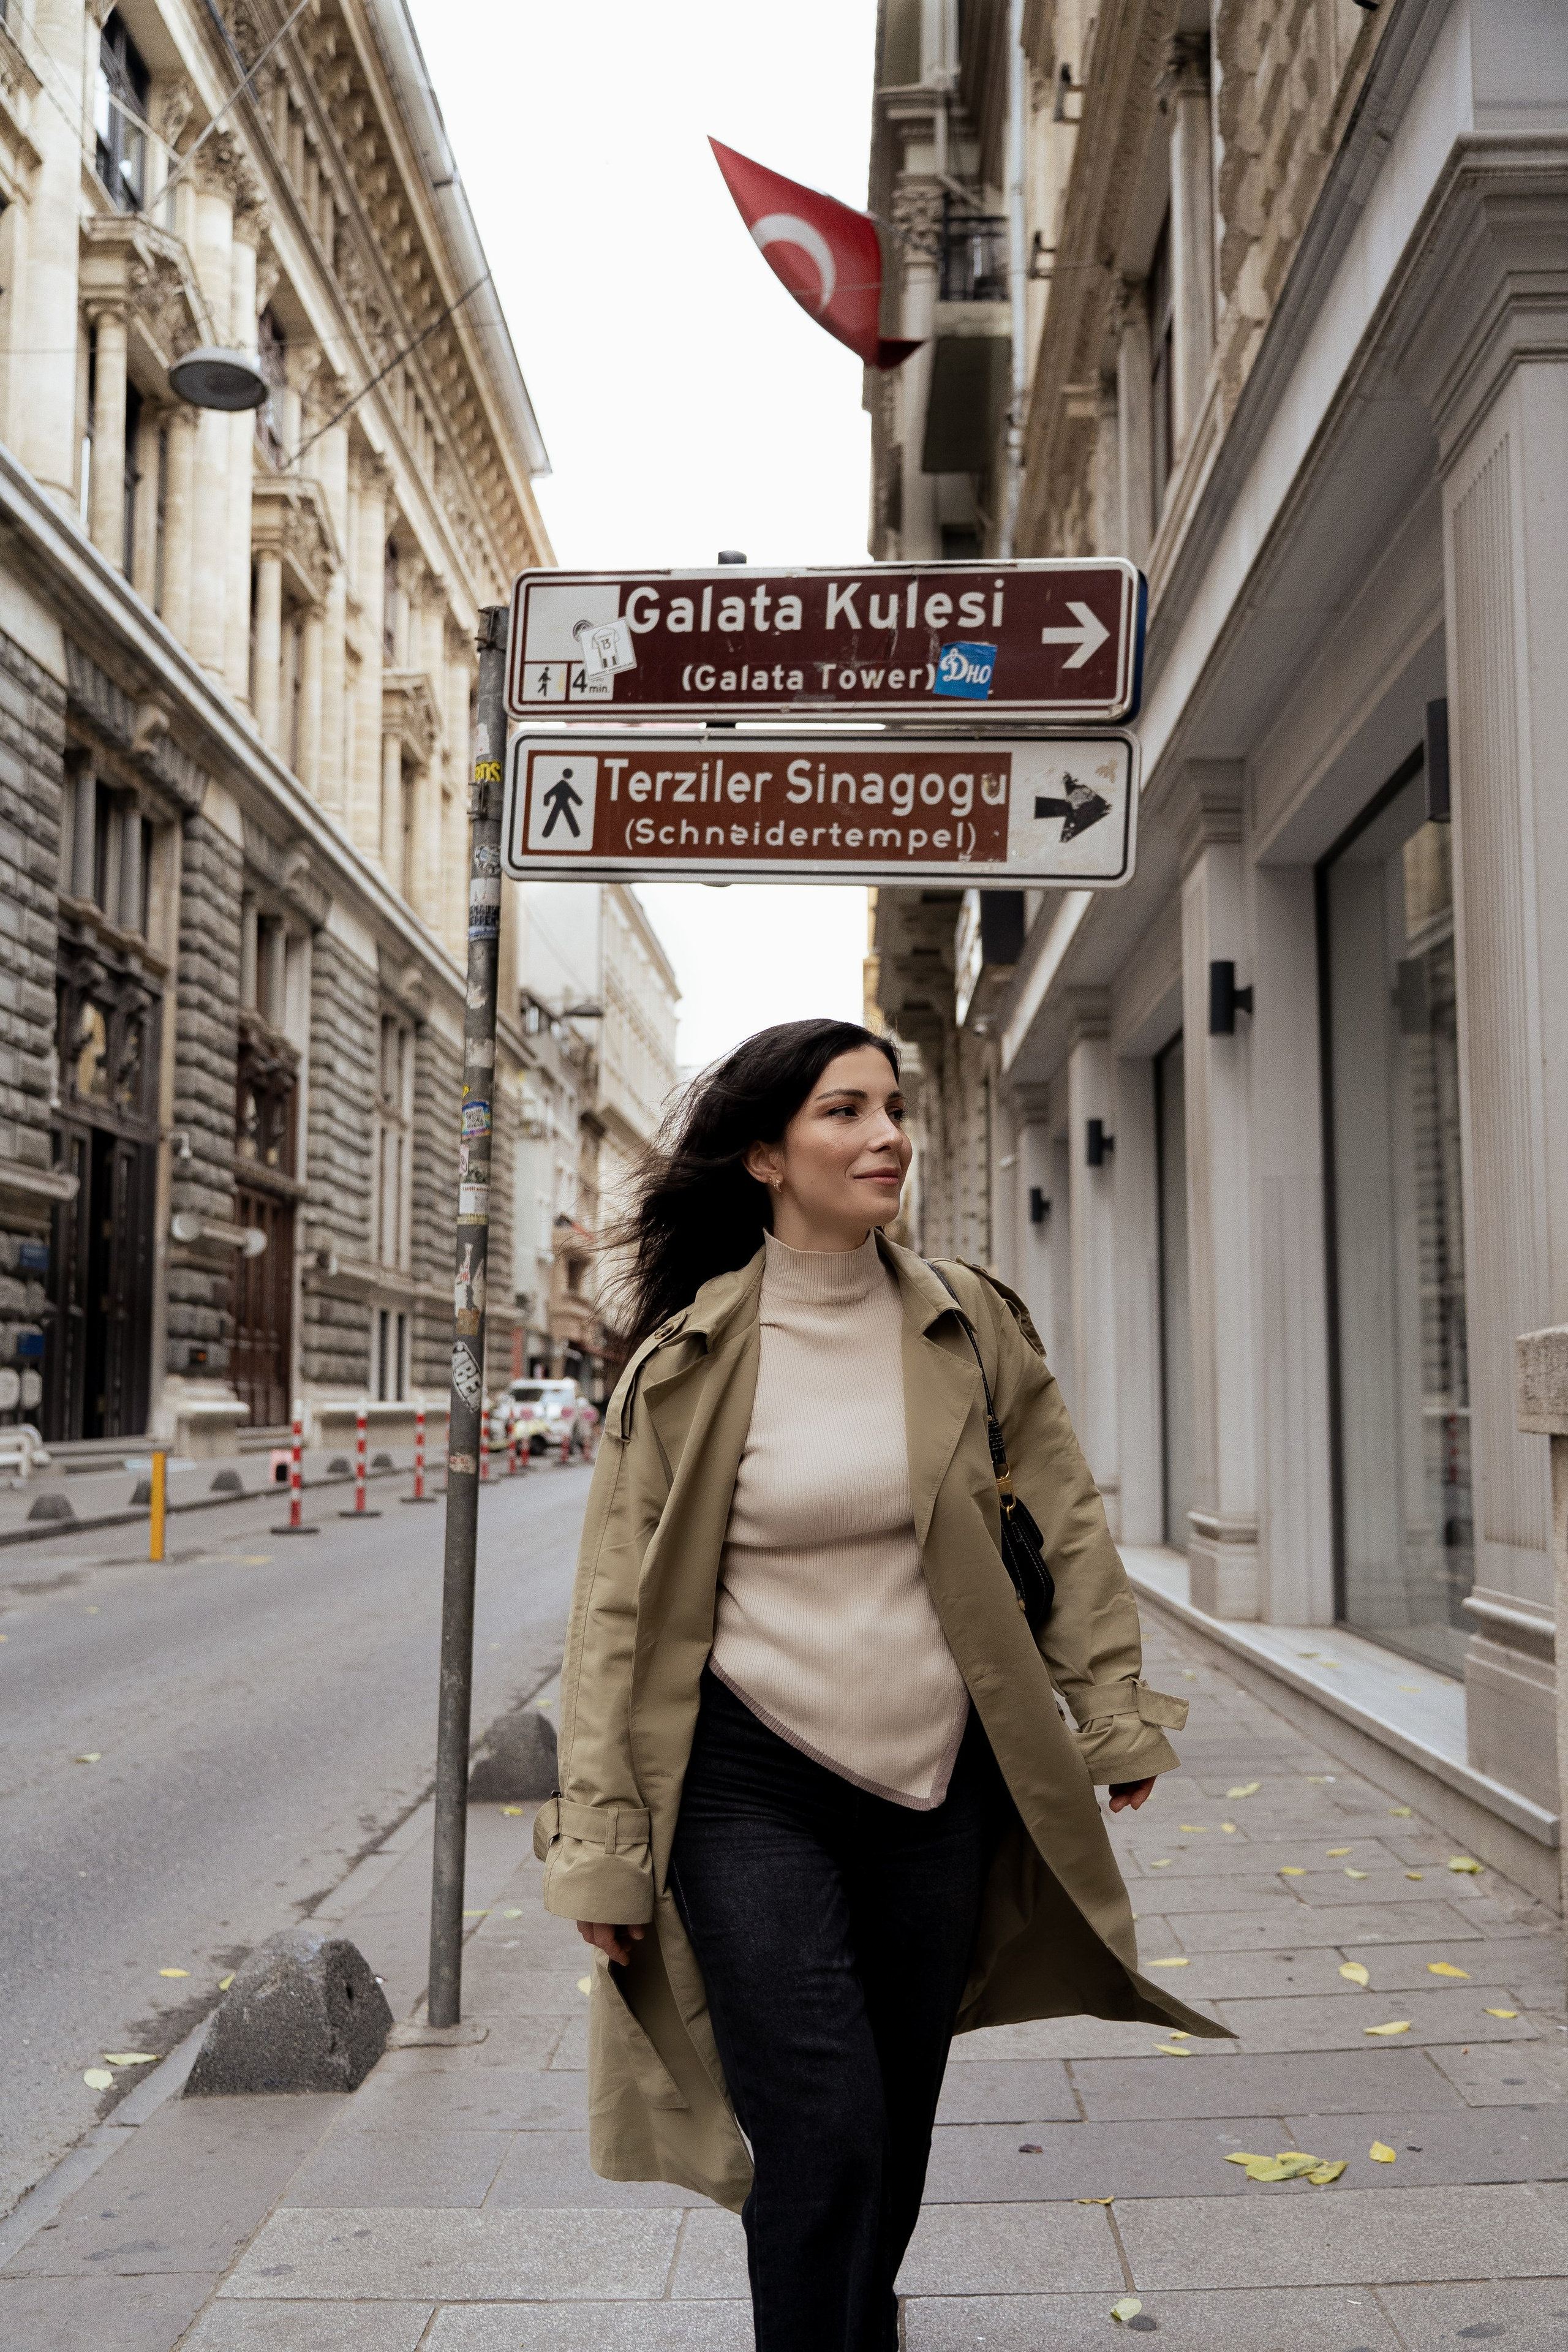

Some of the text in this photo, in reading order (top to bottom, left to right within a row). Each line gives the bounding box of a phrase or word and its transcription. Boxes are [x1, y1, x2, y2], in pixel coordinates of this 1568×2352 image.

[624, 579, 1004, 634] Galata Kulesi
[573, 669, 587, 693] 4
[682, 663, 935, 691] (Galata Tower)
[604, 758, 1006, 816] Terziler Sinagogu
[625, 818, 976, 854] (Schneidertempel)
